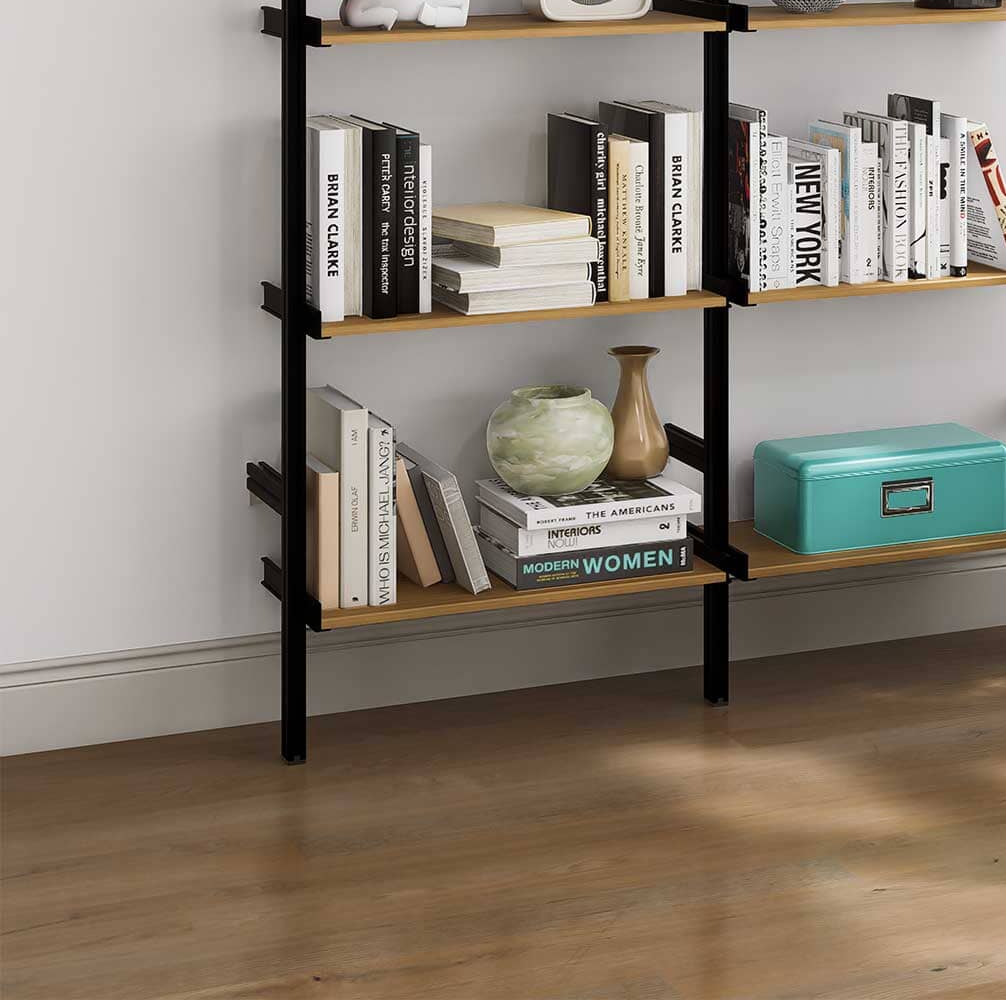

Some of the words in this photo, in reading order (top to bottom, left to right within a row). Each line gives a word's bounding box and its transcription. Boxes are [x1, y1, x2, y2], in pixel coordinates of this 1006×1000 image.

[595, 132, 607, 169] charity
[895, 126, 907, 158] THE
[381, 153, 391, 181] PETER
[595, 171, 607, 191] girl
[671, 155, 683, 198] BRIAN
[959, 168, 966, 177] IN
[327, 174, 339, 219] BRIAN
[381, 184, 391, 212] CAREY
[634, 164, 644, 203] Charlotte
[795, 164, 822, 215] NEW
[867, 166, 876, 211] INTERIORS
[895, 161, 907, 229] FASHION
[381, 222, 391, 236] the
[596, 198, 607, 239] michael
[671, 202, 683, 254] CLARKE
[327, 223, 339, 278] CLARKE
[635, 235, 646, 257] Jane
[769, 225, 783, 273] Snaps
[795, 221, 822, 284] YORK
[865, 257, 872, 267] 2
[895, 233, 907, 280] BOOK
[635, 258, 646, 277] Eyre
[351, 429, 358, 442] AM
[378, 440, 391, 485] JANG?
[351, 486, 360, 507] OLAF
[585, 510, 607, 520] THE
[610, 502, 676, 518] AMERICANS
[351, 506, 360, 533] ERWIN
[378, 486, 391, 550] MICHAEL
[547, 524, 602, 540] INTERIORS
[659, 521, 671, 531] 2
[378, 551, 391, 568] IS
[522, 558, 580, 575] MODERN
[582, 547, 674, 576] WOMEN
[378, 571, 391, 605] WHO
